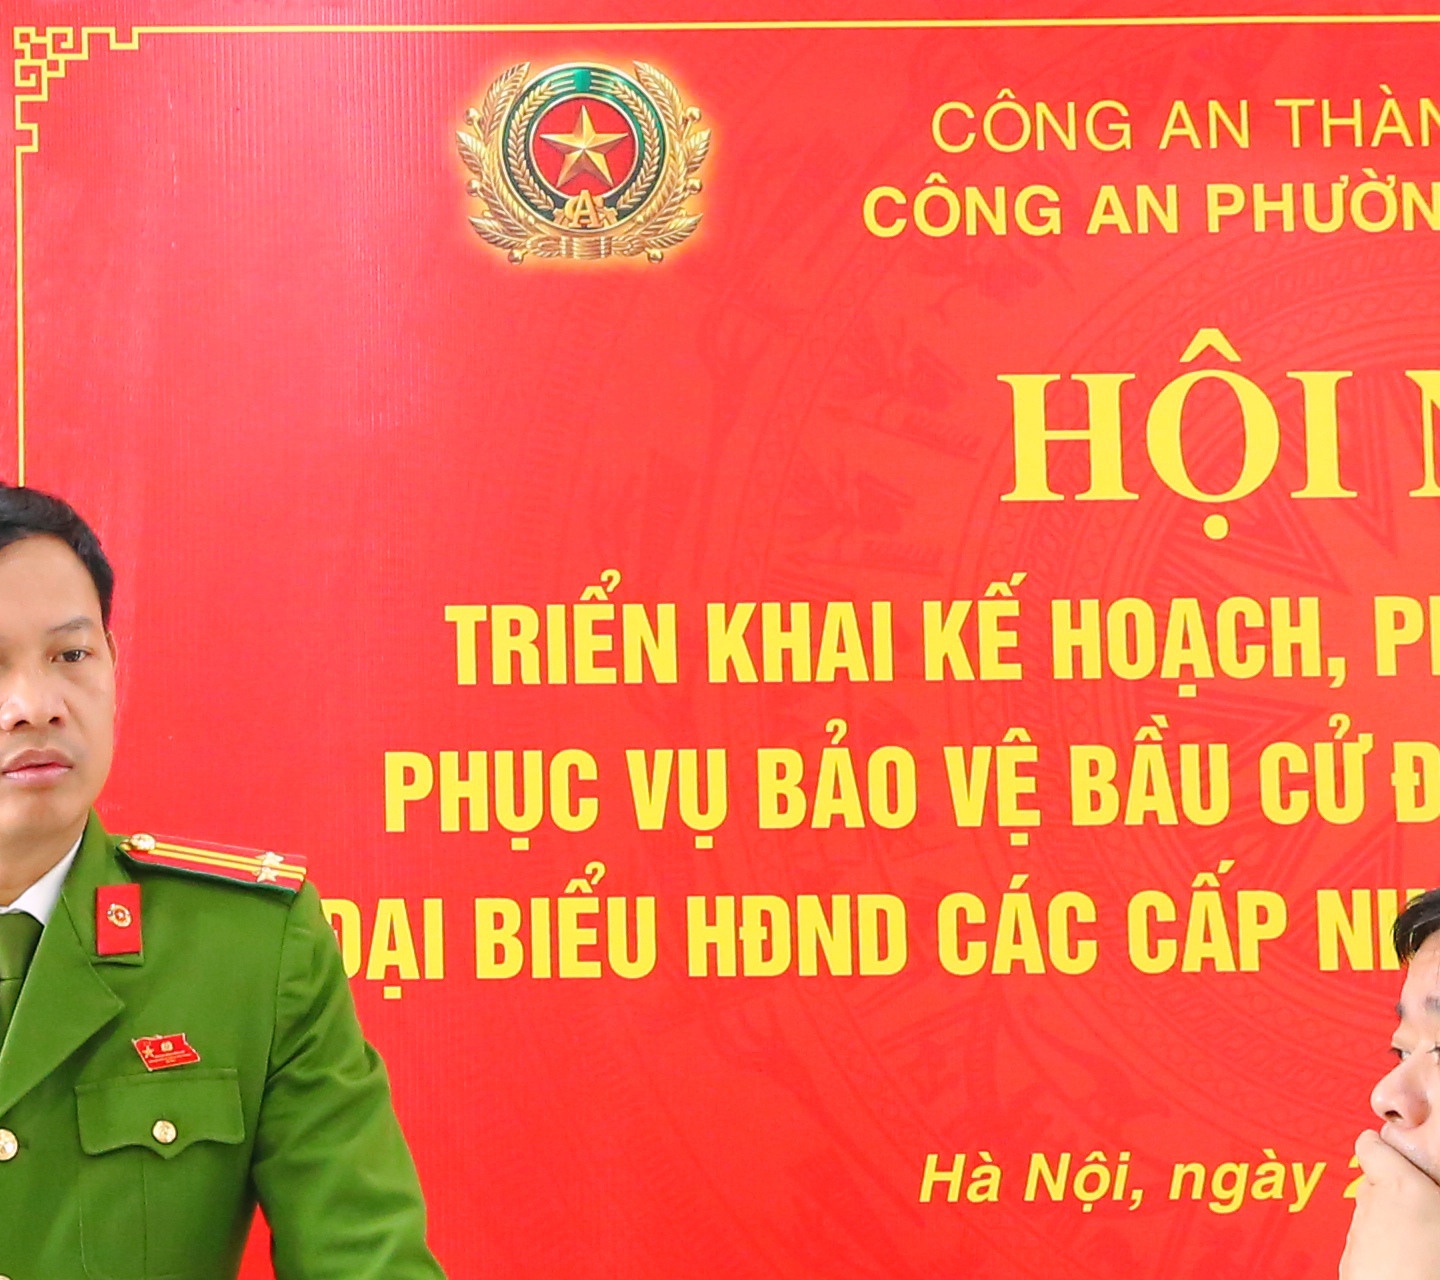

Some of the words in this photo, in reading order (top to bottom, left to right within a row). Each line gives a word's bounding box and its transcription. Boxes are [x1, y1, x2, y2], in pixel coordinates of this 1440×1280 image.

[932, 88, 1131, 153] CÔNG
[1159, 100, 1249, 149] AN
[863, 172, 1061, 237] CÔNG
[1087, 185, 1178, 234] AN
[997, 328, 1357, 540] HỘI
[445, 569, 677, 685] TRIỂN
[707, 601, 893, 683] KHAI
[923, 572, 1027, 681] KẾ
[1052, 596, 1346, 697] HOẠCH,
[385, 749, 598, 850] PHỤC
[626, 749, 727, 849] VỤ
[758, 719, 916, 829] BẢO
[944, 728, 1040, 846] VỆ
[1070, 715, 1230, 826] BẦU
[1260, 713, 1373, 825] CỬ
[475, 862, 656, 979] BIỂU
[687, 894, 907, 977] HĐND
[938, 874, 1097, 975] CÁC
[1128, 860, 1287, 974] CẤP
[920, 1152, 1001, 1202] Hà
[1024, 1151, 1143, 1212] Nội,
[1169, 1149, 1326, 1213] ngày
